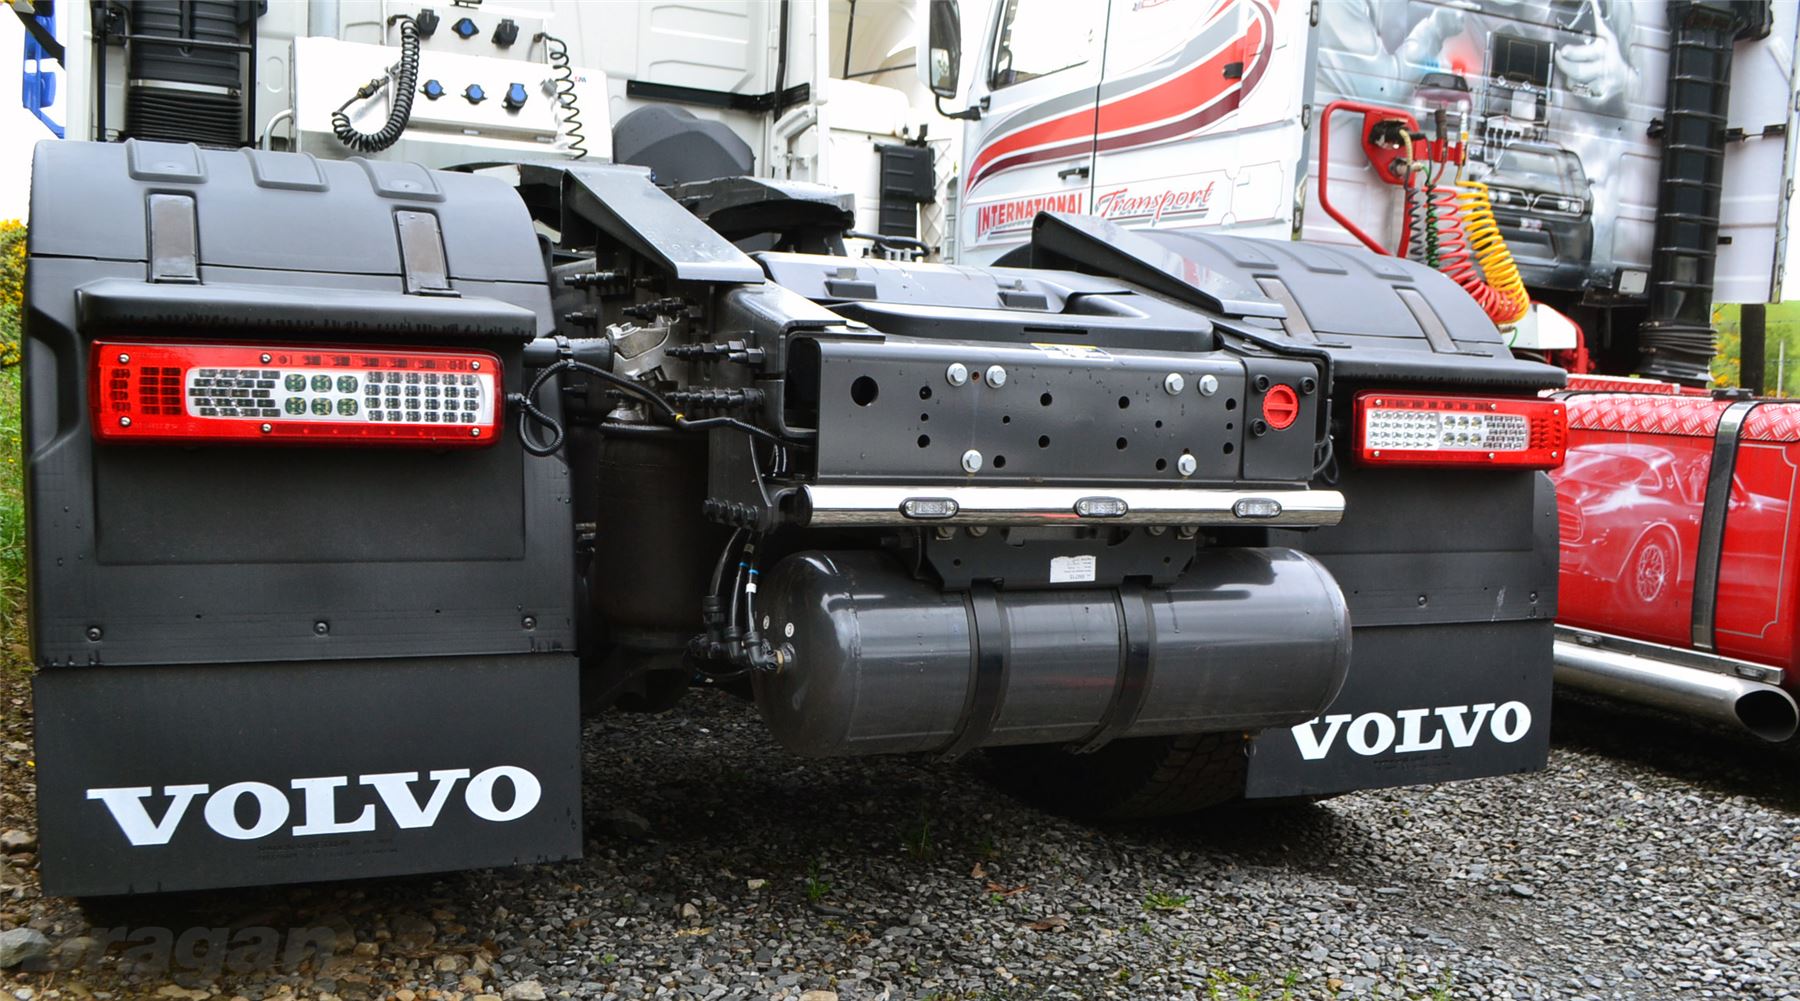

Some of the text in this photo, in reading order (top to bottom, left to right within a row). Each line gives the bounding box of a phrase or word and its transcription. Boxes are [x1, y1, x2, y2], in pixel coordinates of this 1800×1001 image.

[977, 181, 1215, 238] INTERNATIONAL Transport
[1291, 700, 1532, 760] VOLVO
[87, 765, 542, 846] VOLVO
